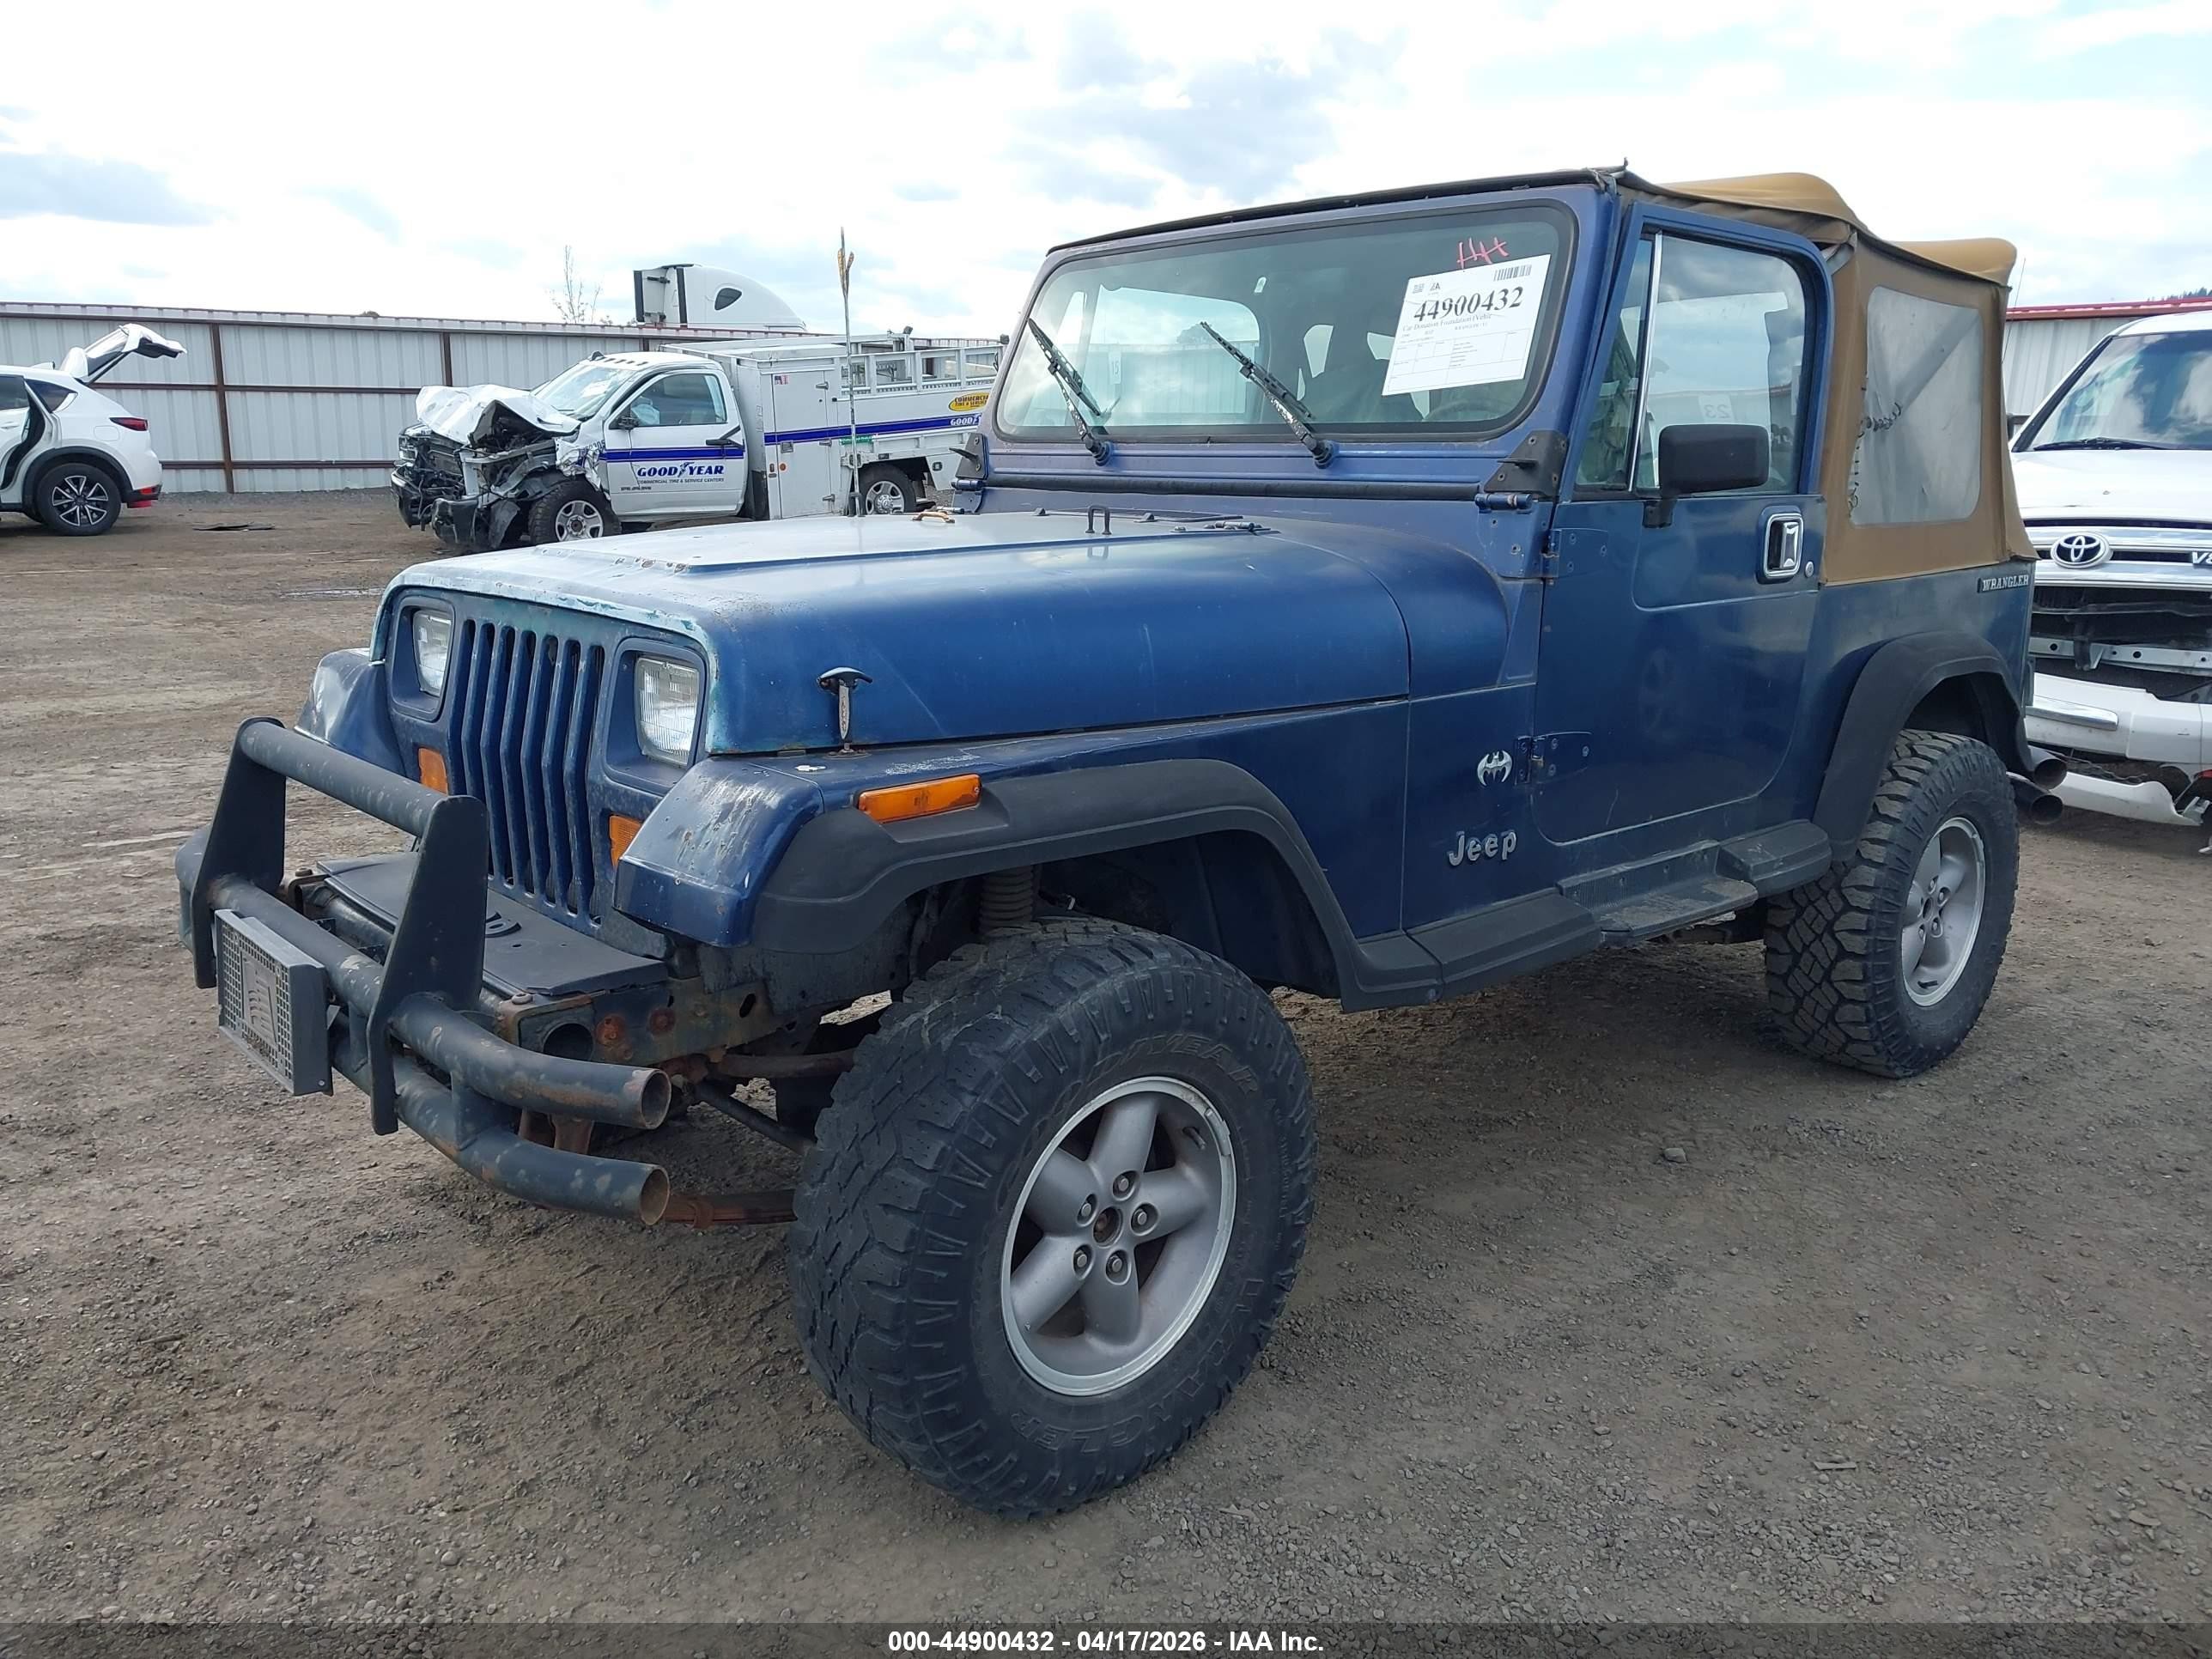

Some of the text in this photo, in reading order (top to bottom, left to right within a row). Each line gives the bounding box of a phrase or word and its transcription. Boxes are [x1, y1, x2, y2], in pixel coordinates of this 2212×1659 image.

[1413, 286, 1524, 322] 44900432
[1982, 574, 2029, 592] WRANGLER
[1448, 830, 1517, 866] Jeep
